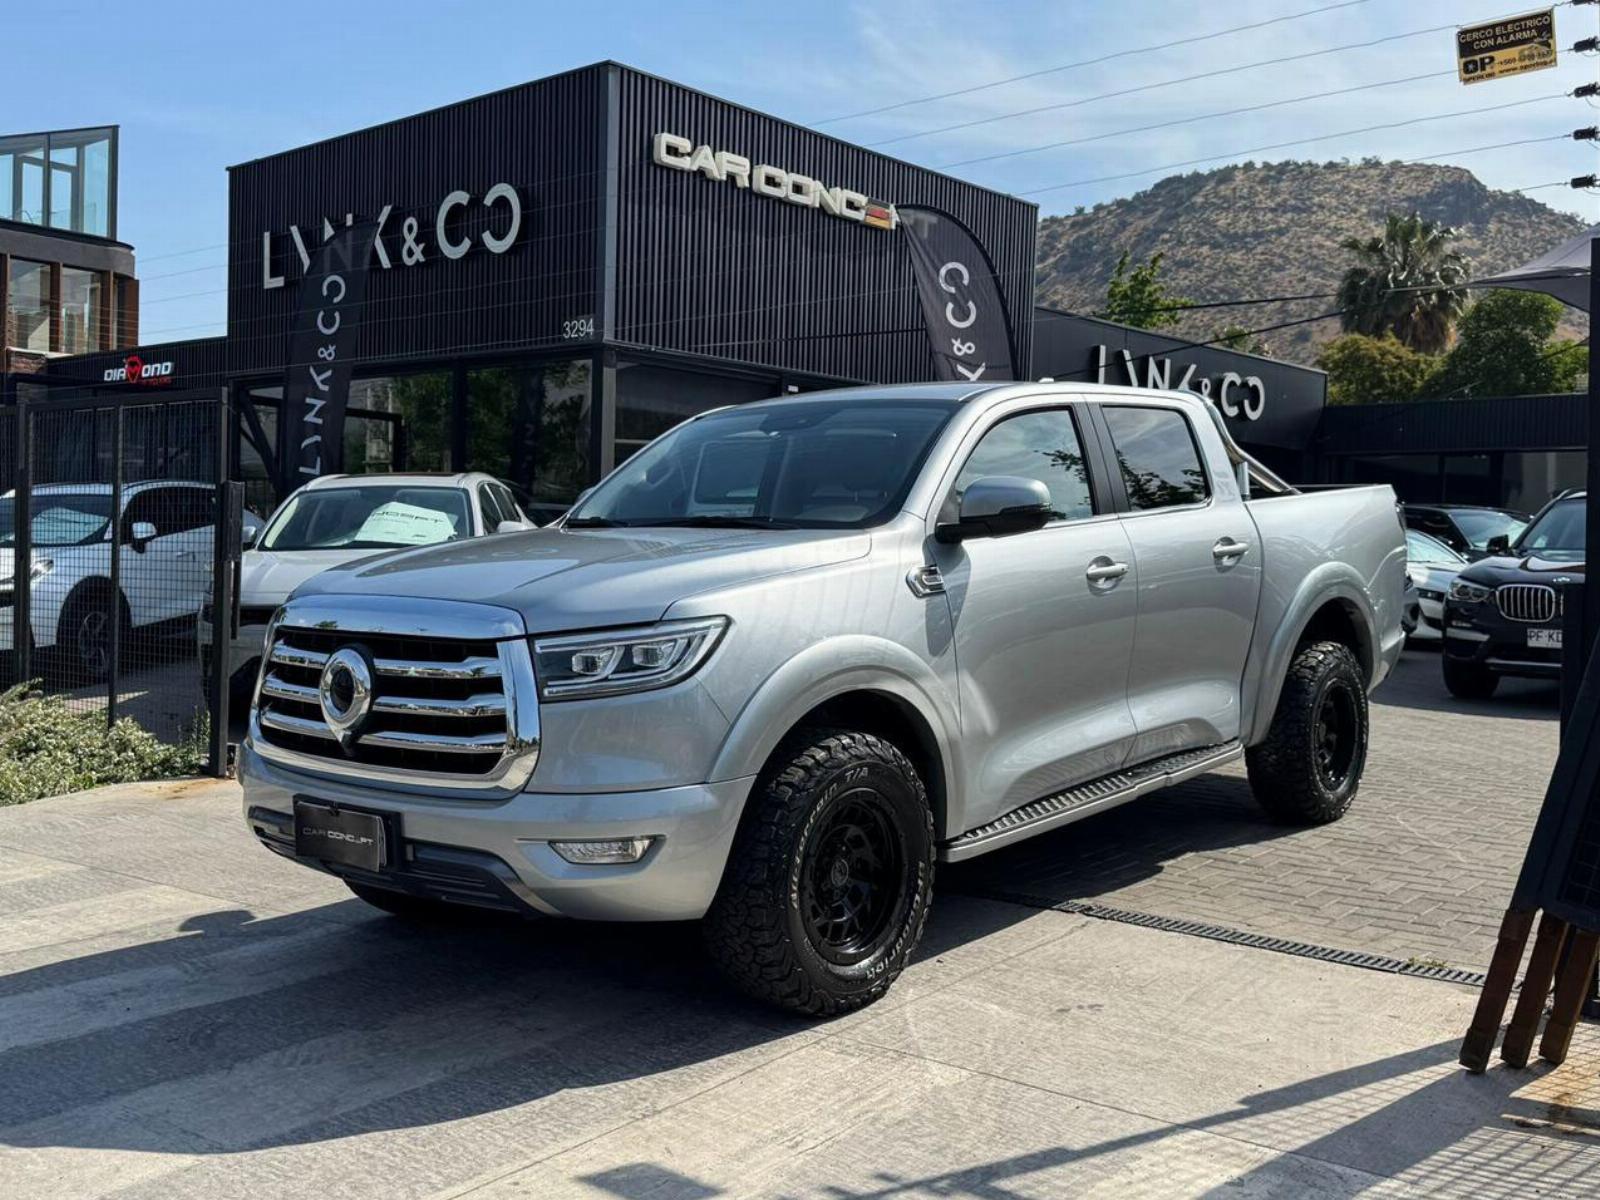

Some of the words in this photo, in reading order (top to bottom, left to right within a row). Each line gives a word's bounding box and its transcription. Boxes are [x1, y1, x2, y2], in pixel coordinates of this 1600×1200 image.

[1460, 28, 1493, 43] CERCO
[1495, 15, 1551, 36] ELECTRICO
[1473, 39, 1495, 50] CON
[1496, 29, 1538, 45] ALARMA
[653, 132, 750, 189] CAR
[562, 318, 595, 339] 3294
[845, 767, 869, 783] T/A
